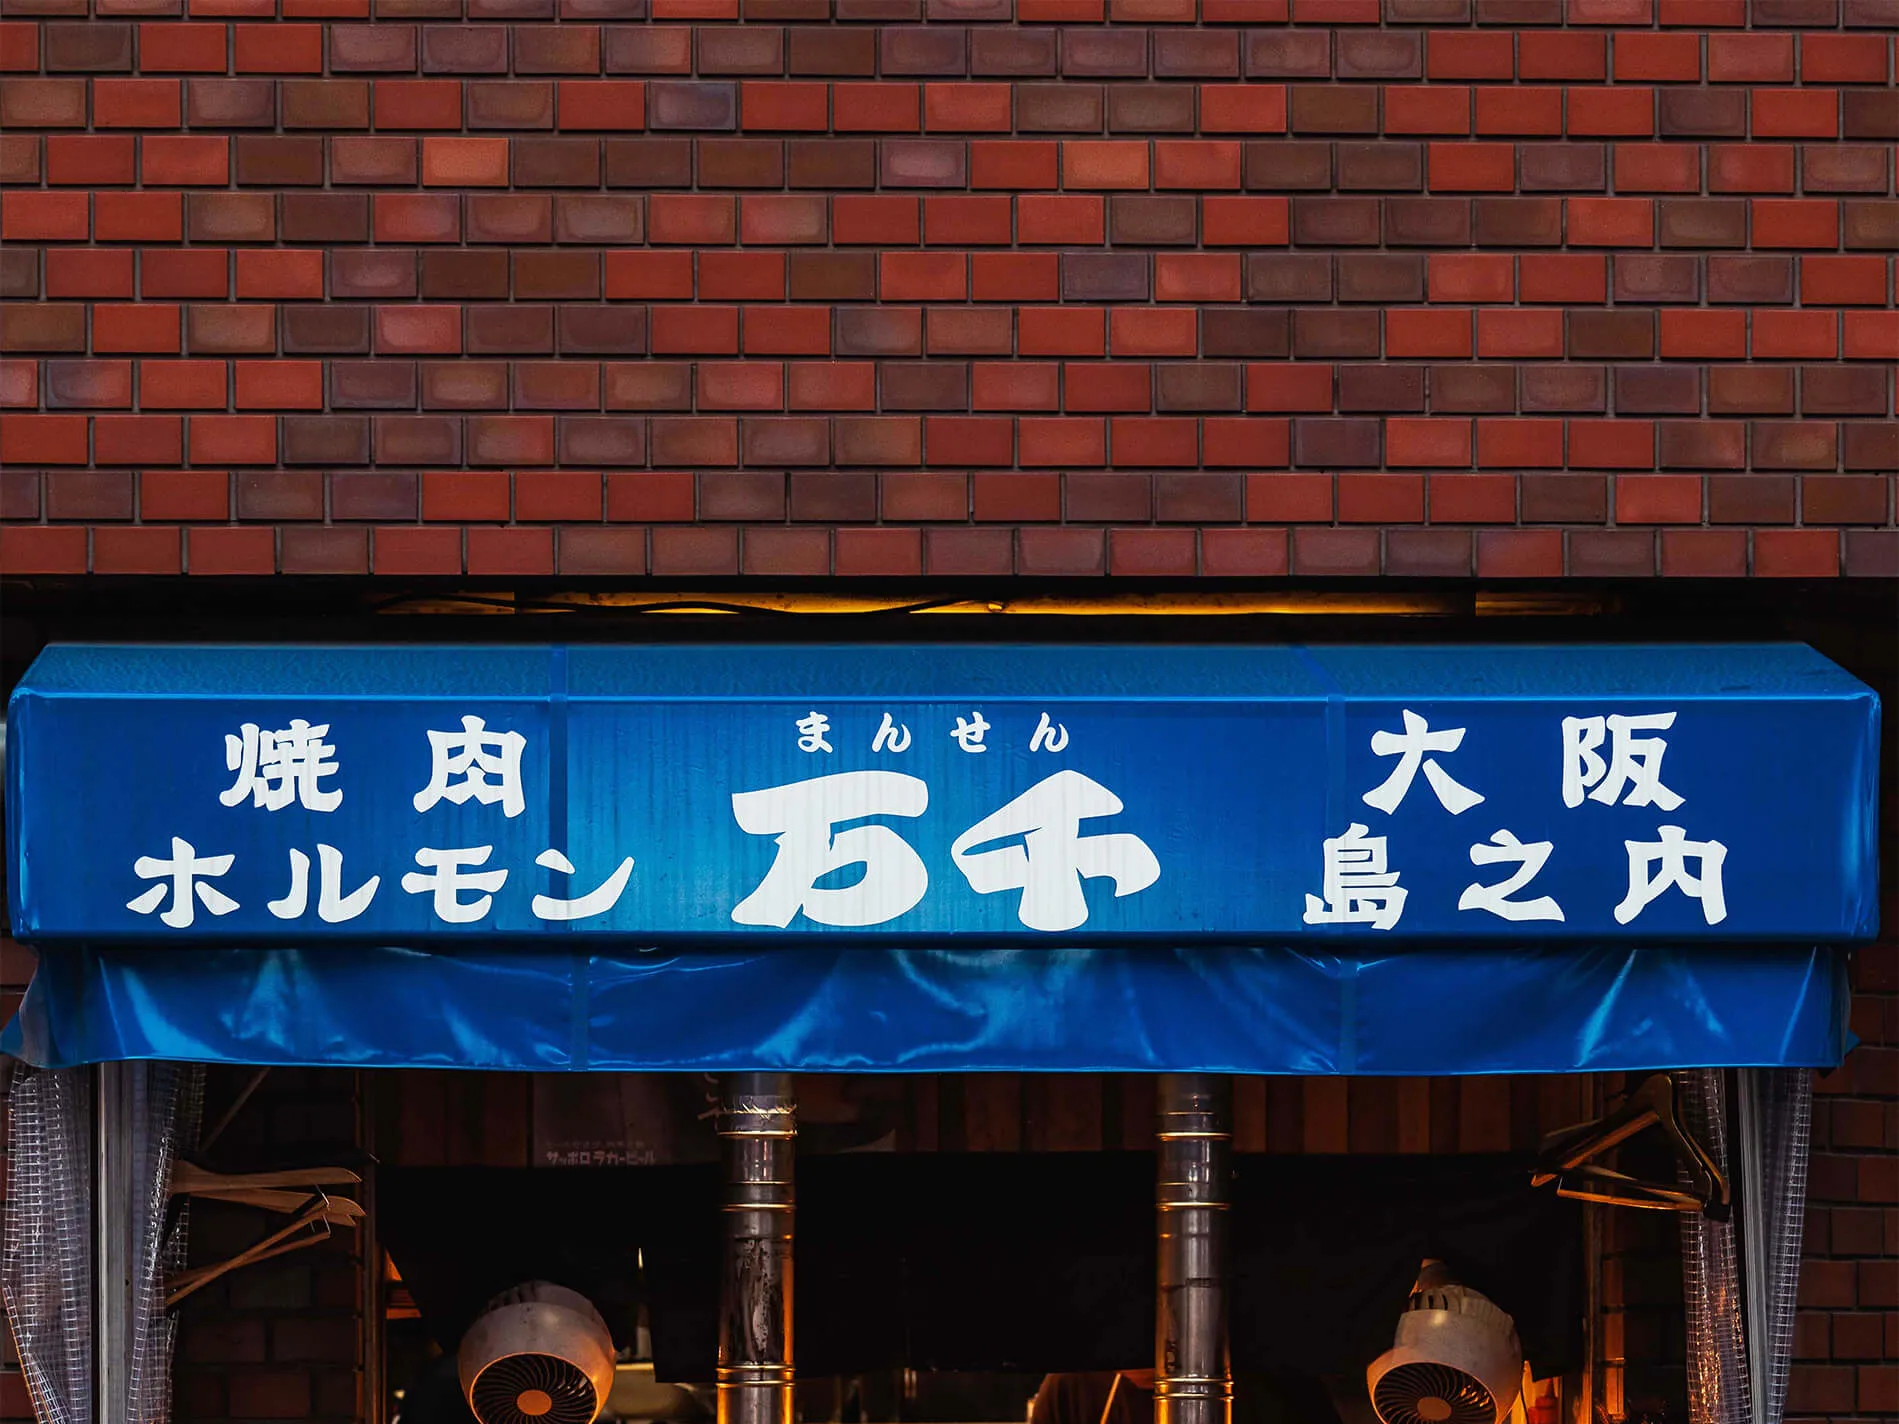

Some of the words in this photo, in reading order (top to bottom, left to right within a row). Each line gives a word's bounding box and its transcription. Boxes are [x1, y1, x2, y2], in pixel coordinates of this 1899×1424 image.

[220, 715, 527, 817] 焼肉
[796, 711, 1069, 754] まんせん
[1362, 708, 1686, 815] 大阪
[126, 836, 635, 929] ホルモン
[731, 770, 1161, 931] 万千
[1303, 823, 1728, 930] 島之内
